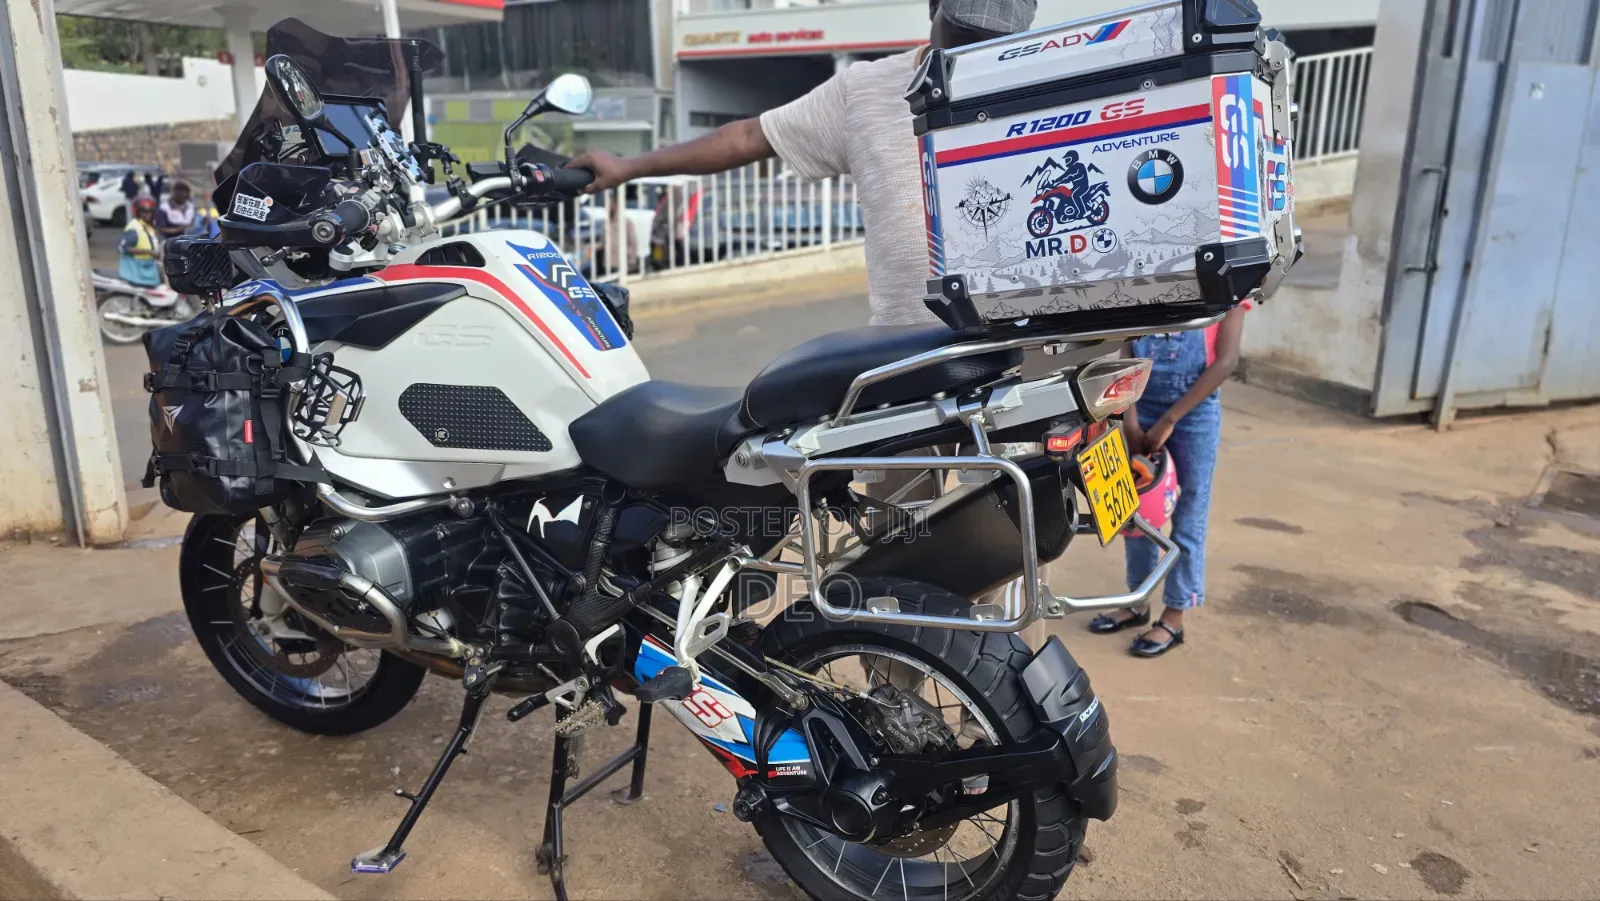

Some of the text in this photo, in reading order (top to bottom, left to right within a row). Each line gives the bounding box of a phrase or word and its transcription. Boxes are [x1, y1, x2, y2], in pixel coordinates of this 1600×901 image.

[1100, 98, 1147, 122] GS
[1092, 131, 1180, 155] ADVENTURE
[1025, 233, 1087, 259] MR.D
[1095, 436, 1123, 481] UGA
[1103, 474, 1135, 528] 567N
